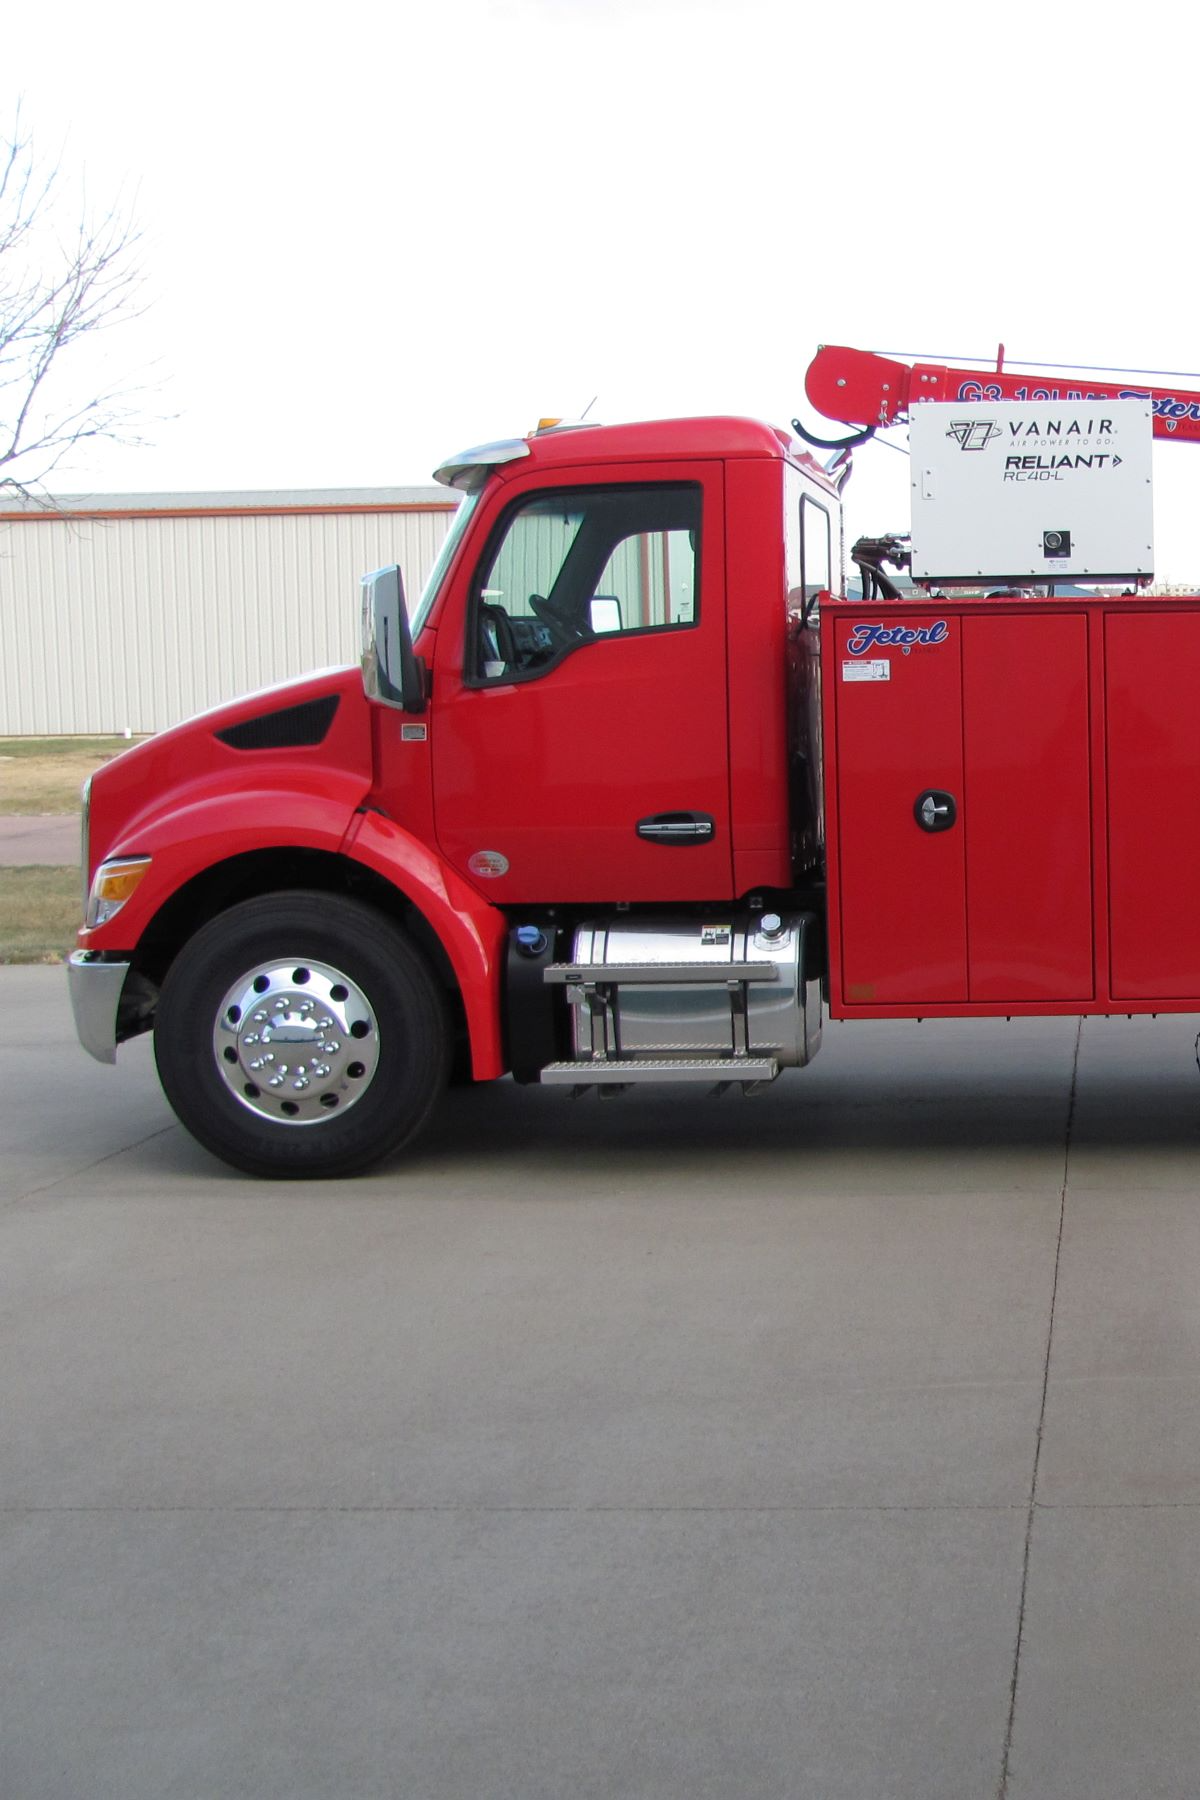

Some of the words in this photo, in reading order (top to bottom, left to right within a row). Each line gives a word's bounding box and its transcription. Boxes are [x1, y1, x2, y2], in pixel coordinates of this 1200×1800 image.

[1077, 438, 1089, 446] TO
[1005, 454, 1110, 470] RELIANT
[1003, 470, 1064, 482] RC40-L
